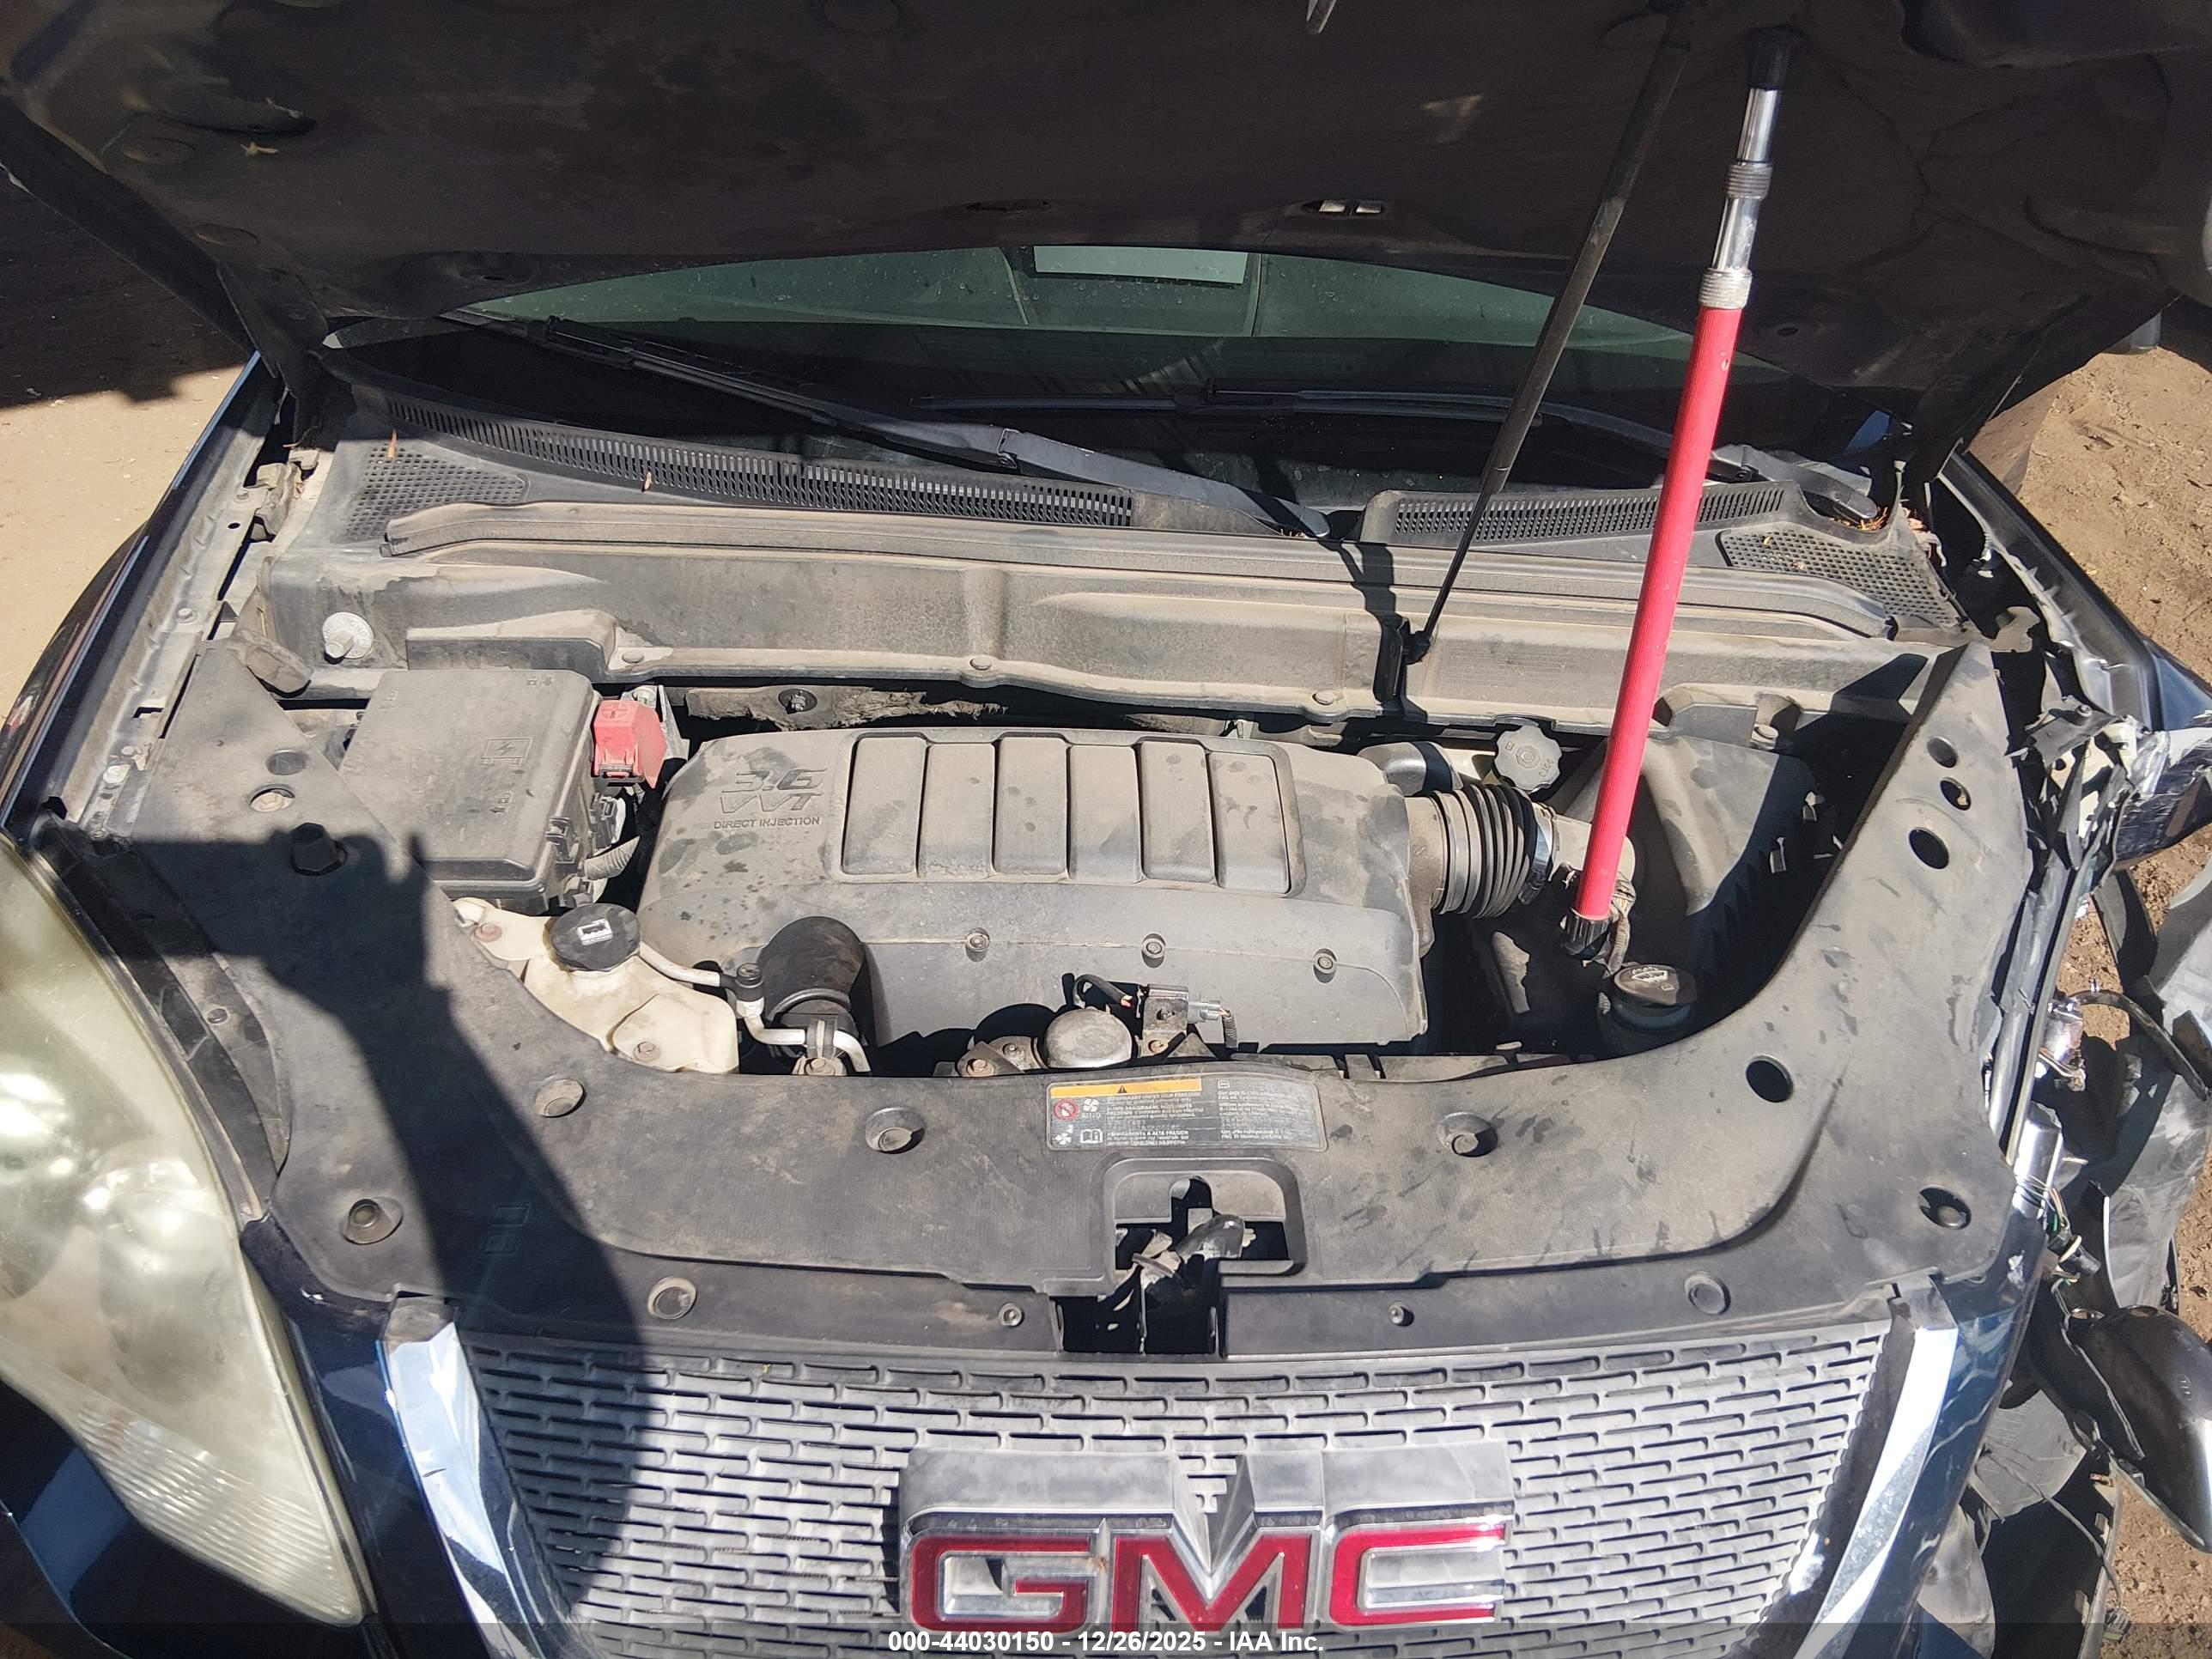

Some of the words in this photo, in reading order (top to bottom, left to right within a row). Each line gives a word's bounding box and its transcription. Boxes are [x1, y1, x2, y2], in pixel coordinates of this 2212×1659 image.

[721, 769, 828, 793] 3.6
[720, 793, 823, 814] VVT
[714, 819, 757, 829] DIRECT
[759, 817, 820, 827] INJECTION
[907, 1520, 1508, 1633] GMC
